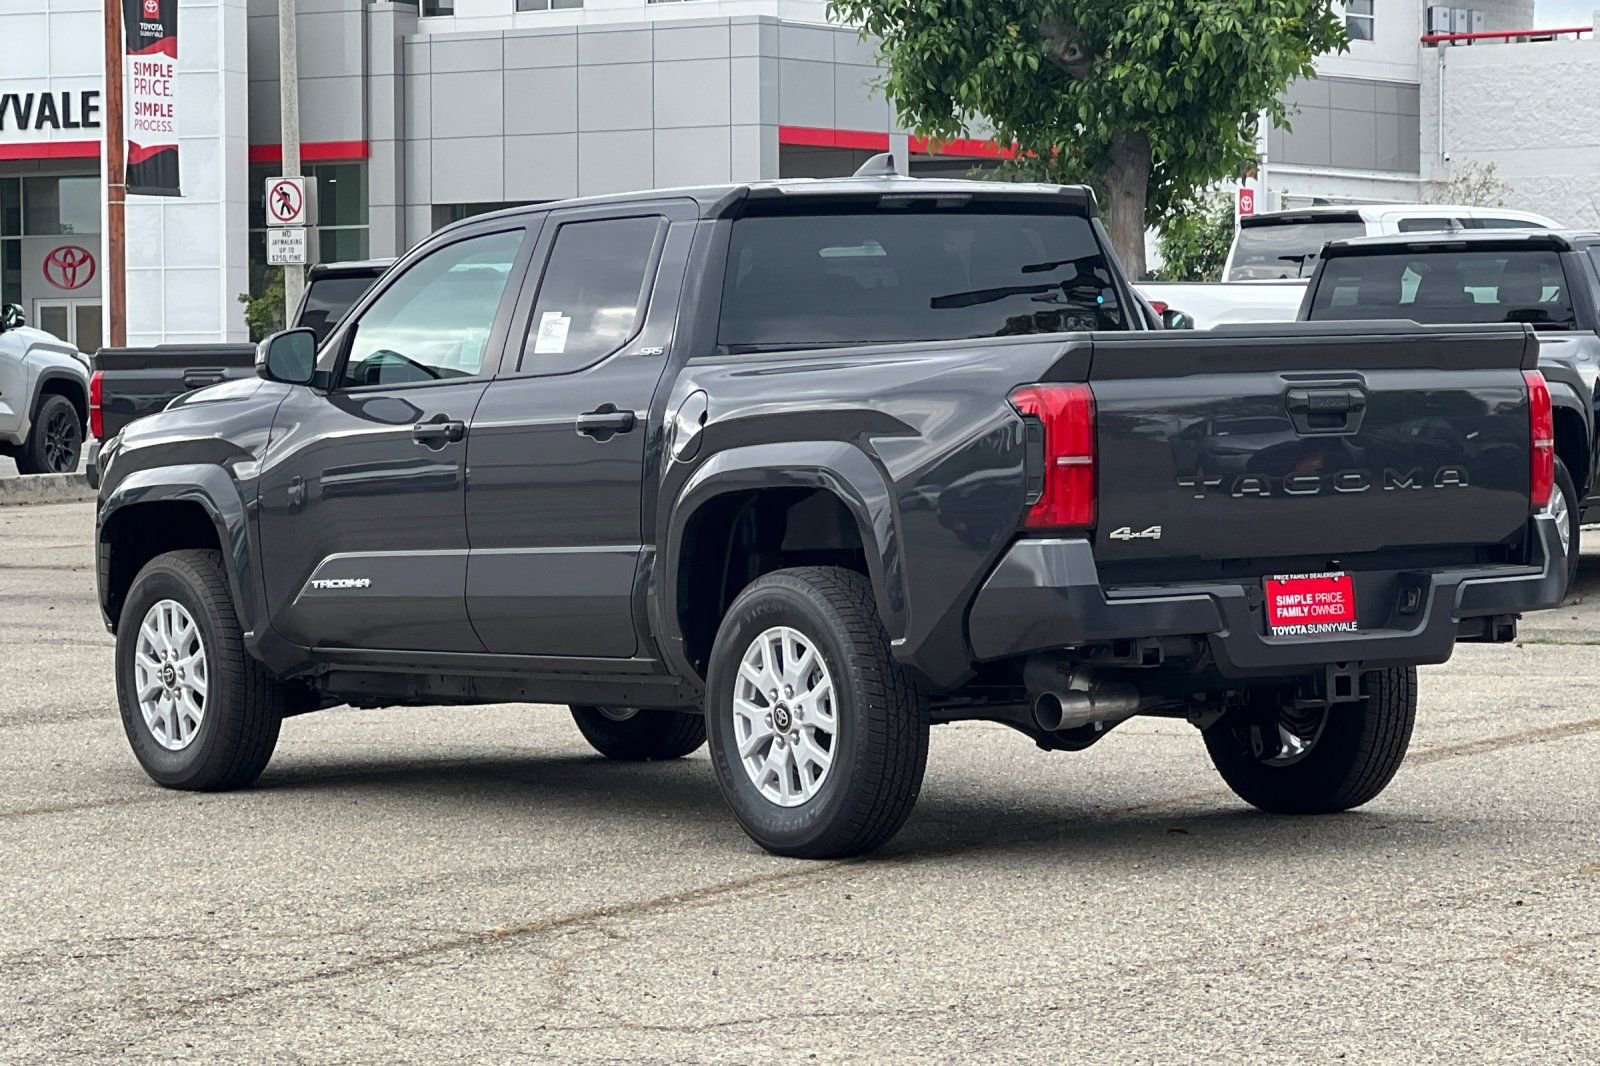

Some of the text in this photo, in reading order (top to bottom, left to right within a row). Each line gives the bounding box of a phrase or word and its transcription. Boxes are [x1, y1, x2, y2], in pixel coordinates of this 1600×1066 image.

[140, 22, 163, 31] TOYOTA
[134, 61, 173, 78] SIMPLE
[134, 78, 173, 97] PRICE.
[135, 101, 173, 118] SIMPLE
[134, 118, 174, 132] PROCESS.
[1176, 464, 1470, 499] TACOMA
[312, 579, 370, 588] TACOMA
[1276, 592, 1345, 605] SIMPLE PRICE.
[1277, 606, 1308, 618] FAMILY
[1272, 622, 1357, 635] TOYOTA SUNNYVALE
